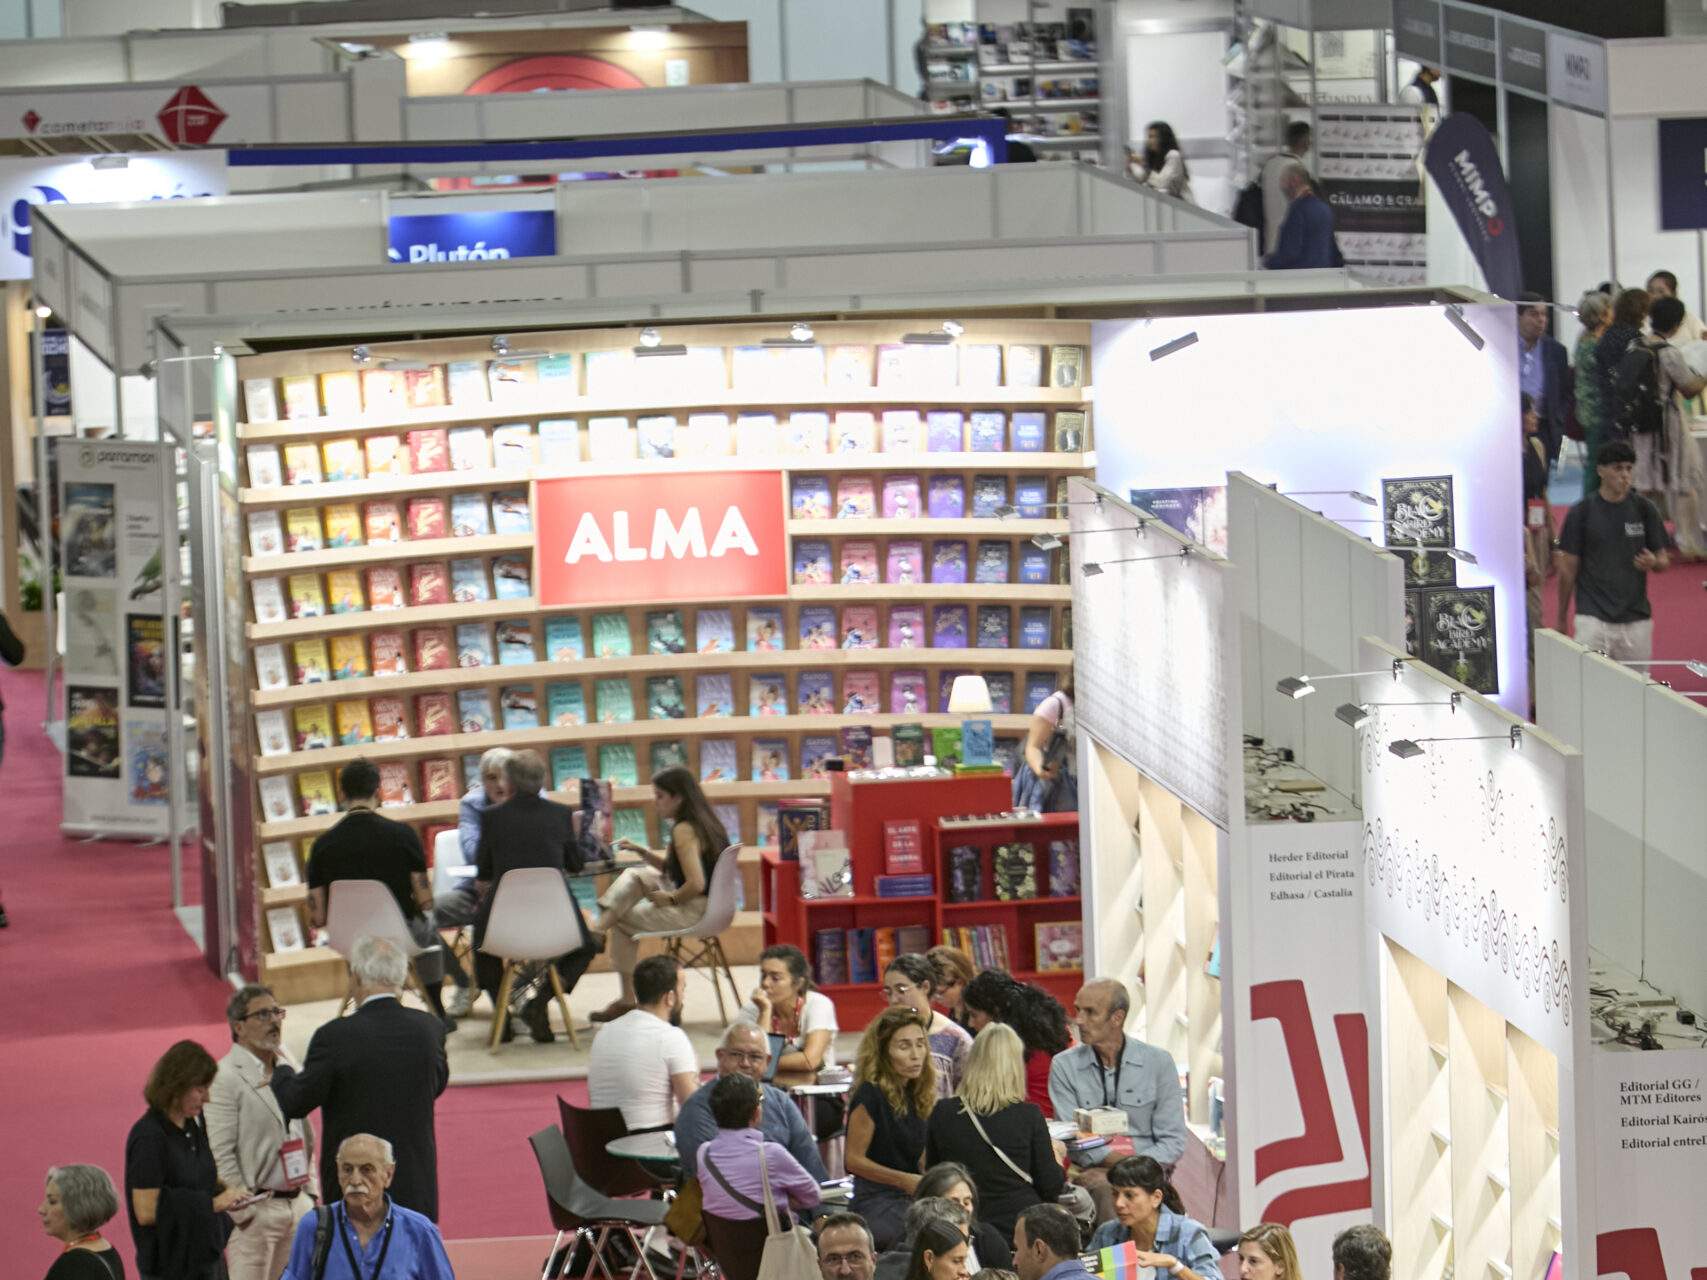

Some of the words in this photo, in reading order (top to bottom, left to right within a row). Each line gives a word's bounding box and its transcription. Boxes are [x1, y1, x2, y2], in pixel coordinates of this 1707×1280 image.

[408, 242, 510, 263] Plutón
[564, 505, 759, 564] ALMA
[1269, 852, 1304, 863] Herder
[1306, 850, 1349, 861] Editorial
[1269, 870, 1312, 882] Editorial
[1314, 870, 1323, 880] el
[1326, 868, 1355, 880] Pirata
[1270, 889, 1305, 901] Edhasa
[1314, 887, 1353, 899] Castalia
[1620, 1080, 1669, 1092] Editorial
[1672, 1079, 1692, 1090] GG
[1620, 1094, 1652, 1106] MTM
[1655, 1092, 1702, 1104] Editores
[1621, 1115, 1670, 1127] Editorial
[1621, 1136, 1670, 1149] Editorial
